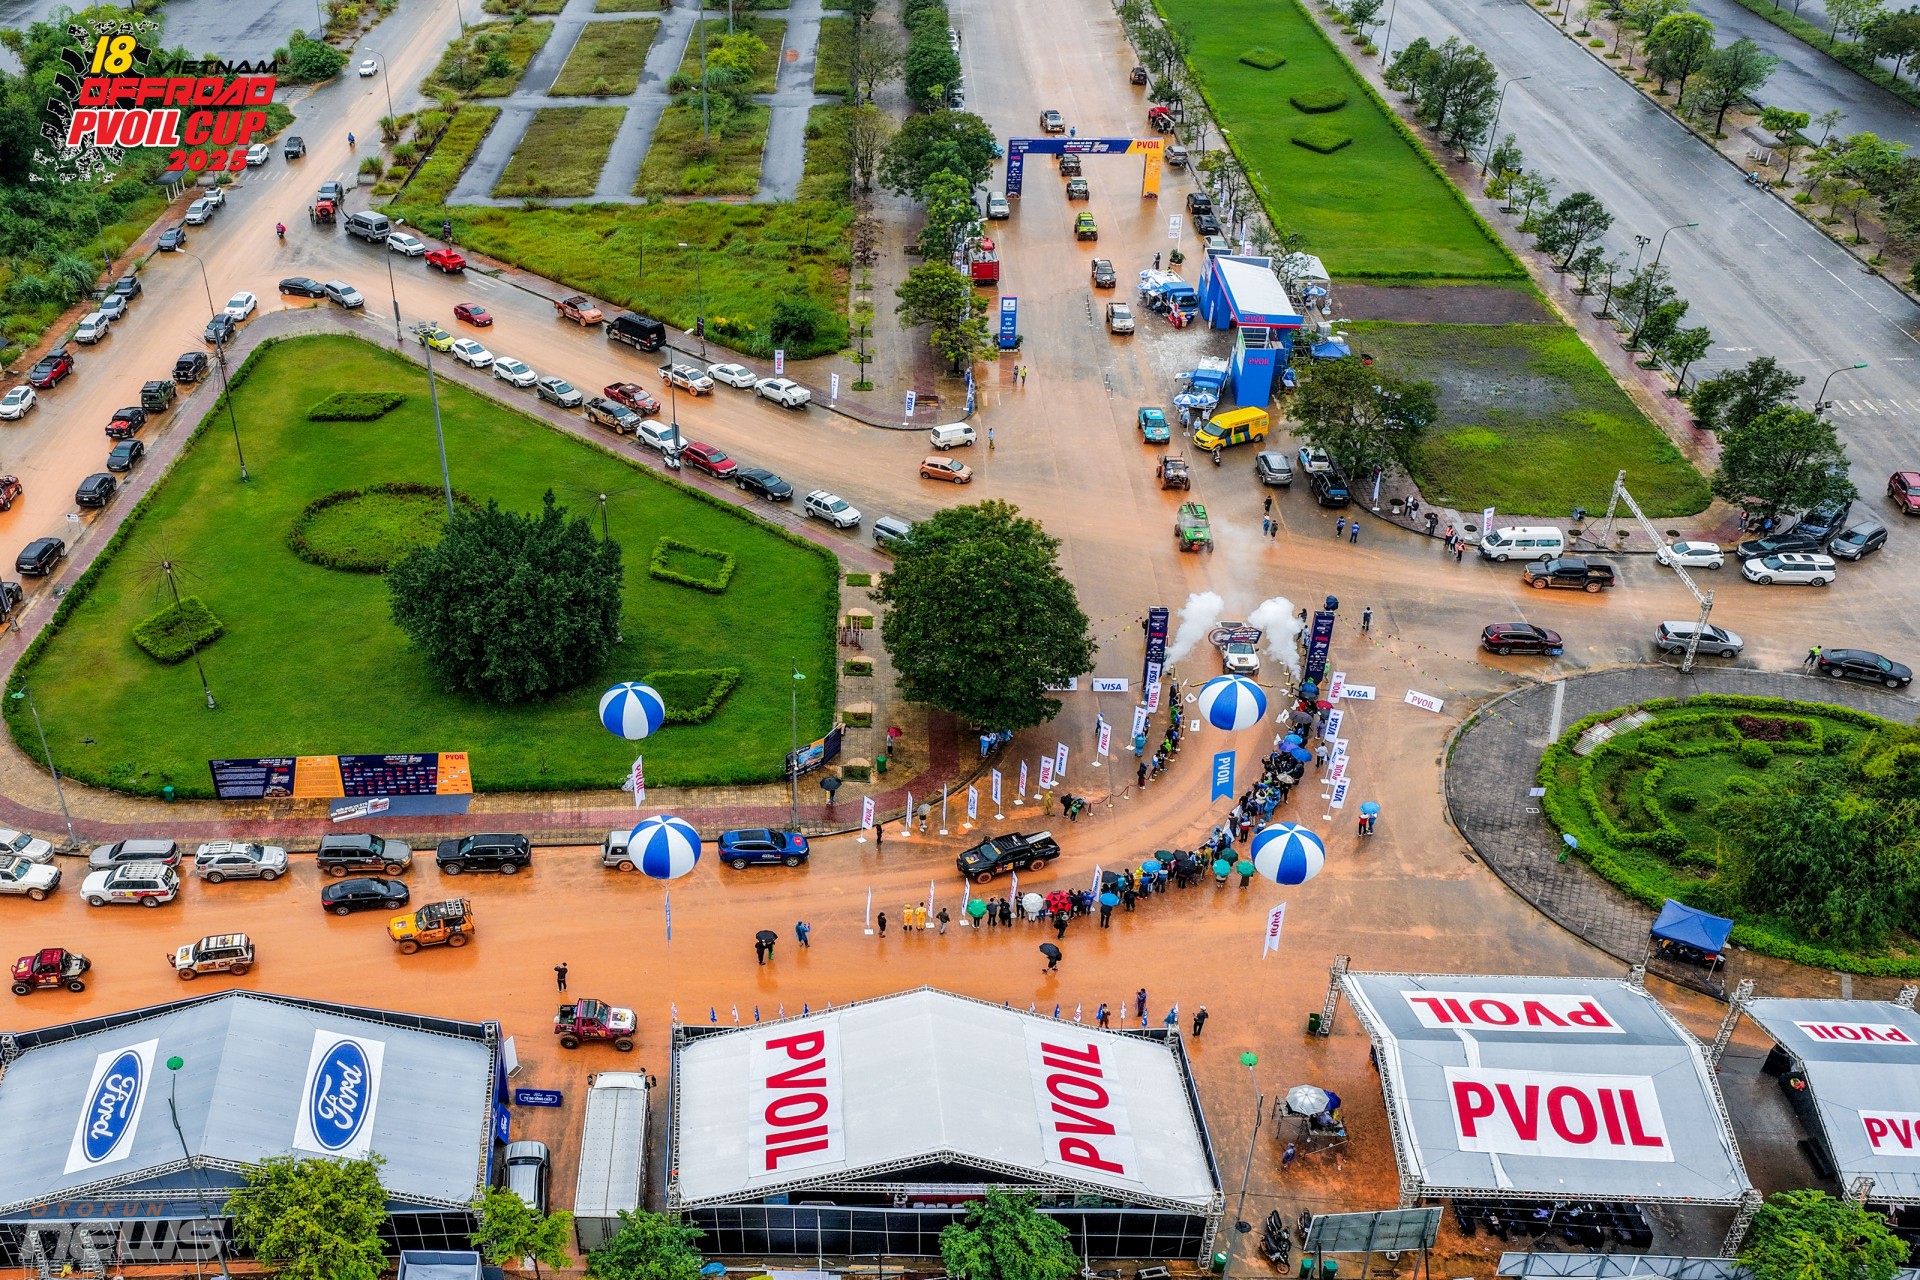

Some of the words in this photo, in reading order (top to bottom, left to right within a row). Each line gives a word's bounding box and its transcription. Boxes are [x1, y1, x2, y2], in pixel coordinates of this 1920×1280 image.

[1136, 141, 1160, 149] PVOIL
[906, 396, 914, 411] VISA
[1101, 683, 1122, 691] VISA
[1330, 681, 1342, 699] PVOIL
[1346, 689, 1369, 699] VISA
[1149, 691, 1158, 708] PVOIL
[1411, 695, 1434, 710] PVOIL
[1327, 717, 1340, 737] VISA
[635, 763, 645, 794] PVOIL
[1041, 766, 1051, 783] PVOIL
[1216, 756, 1231, 786] PVOIL
[1333, 784, 1346, 802] VISA
[865, 807, 873, 826] PVOIL
[1410, 997, 1614, 1027] PVOIL
[1799, 1024, 1911, 1043] PVOIL
[318, 1059, 362, 1130] Ford
[765, 1030, 829, 1170] PVOIL
[91, 1073, 135, 1140] Ford
[1041, 1043, 1124, 1174] PVOIL
[1452, 1081, 1664, 1147] PVOIL
[1863, 1117, 1920, 1149] PV
